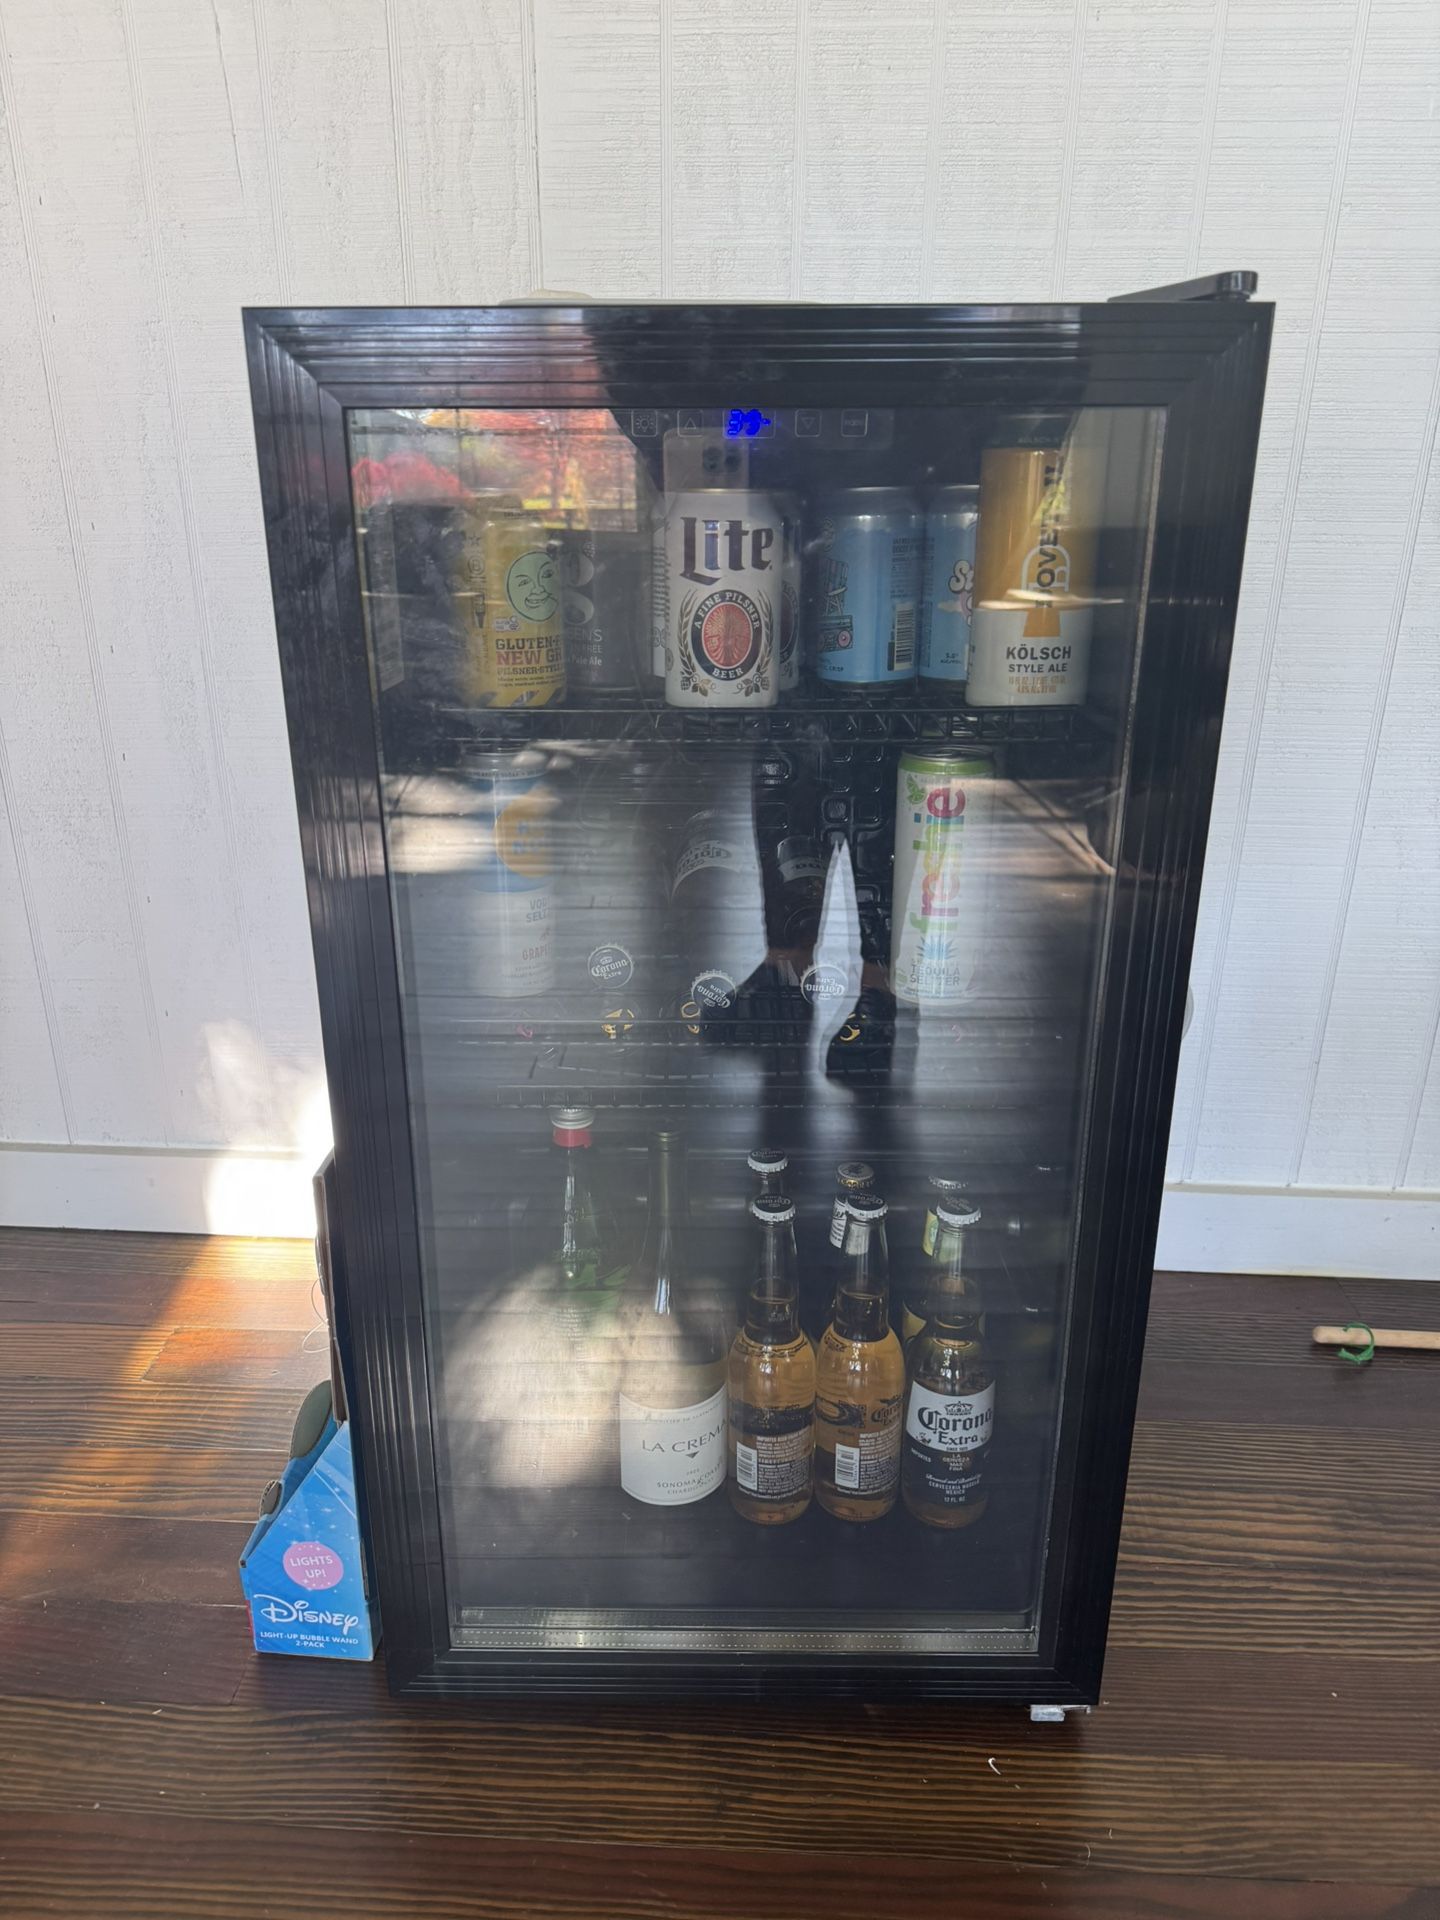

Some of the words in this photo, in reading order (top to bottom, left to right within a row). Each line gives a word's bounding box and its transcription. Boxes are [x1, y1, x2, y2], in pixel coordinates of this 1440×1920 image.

[679, 516, 774, 586] Lite
[694, 619, 703, 630] A
[699, 593, 722, 619] FINE
[724, 591, 761, 630] PILSNER
[496, 650, 541, 666] NEW
[1006, 643, 1072, 660] KÖLSCH
[589, 655, 603, 666] Ale
[711, 666, 744, 680] BEER
[1008, 664, 1045, 673] STYLE
[1047, 663, 1068, 673] ALE
[591, 959, 629, 977] Corona
[911, 964, 960, 976] TEQUILA
[603, 971, 622, 980] Extra
[910, 974, 960, 986] SELTZER
[697, 985, 731, 1008] Corona
[805, 983, 845, 997] Corona
[918, 1407, 993, 1434] Corona
[642, 1440, 665, 1452] LA
[672, 1418, 727, 1452] CREMA
[938, 1431, 978, 1446] Extra
[657, 1478, 699, 1488] SONOMA
[290, 1555, 334, 1567] LIGHTS
[305, 1569, 327, 1578] UP!
[253, 1593, 359, 1636] Disney
[260, 1631, 298, 1640] LIGHT-UP
[300, 1634, 330, 1642] BUBBLE
[331, 1637, 359, 1645] WAND
[296, 1640, 325, 1648] 2-PACK
